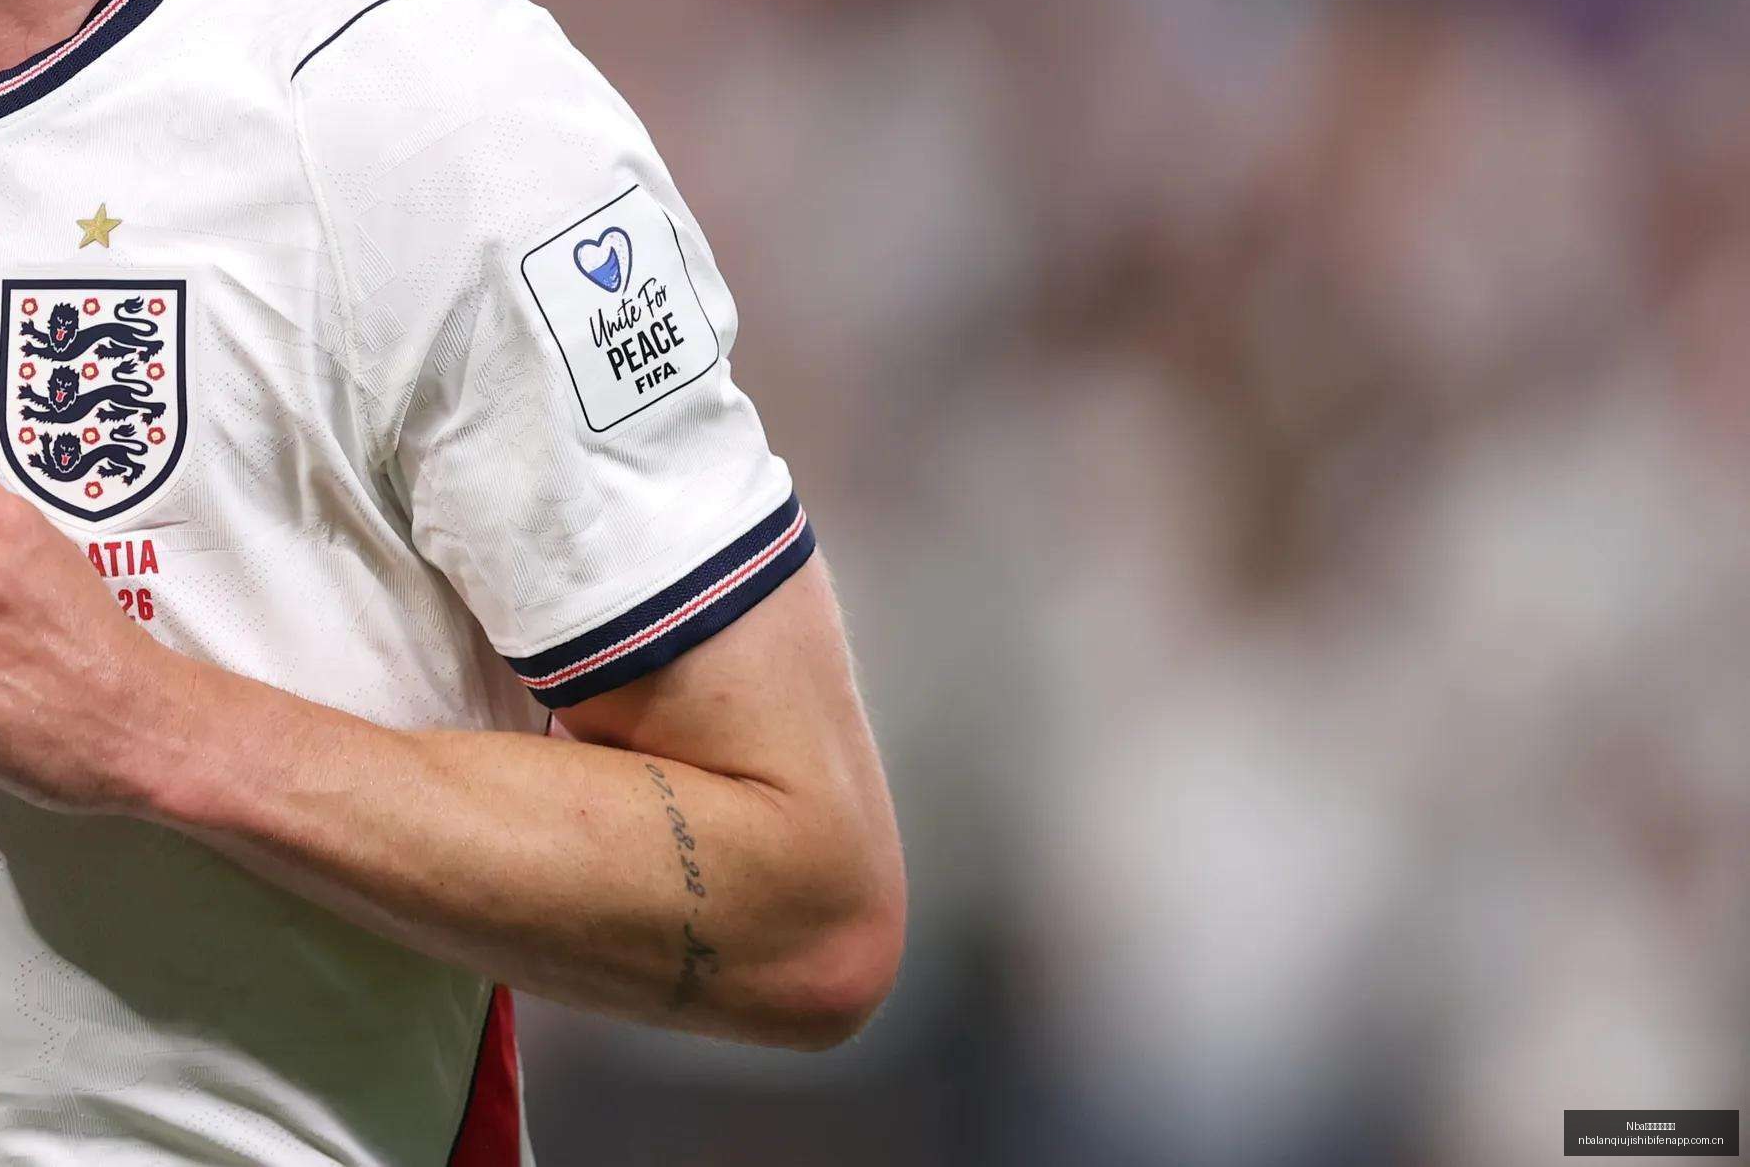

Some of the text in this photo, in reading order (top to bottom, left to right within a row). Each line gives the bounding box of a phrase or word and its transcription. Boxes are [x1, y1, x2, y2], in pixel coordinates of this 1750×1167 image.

[589, 277, 667, 349] Unite For
[606, 311, 685, 382] PEACE
[634, 361, 678, 395] FIFA
[88, 539, 159, 577] ATIA
